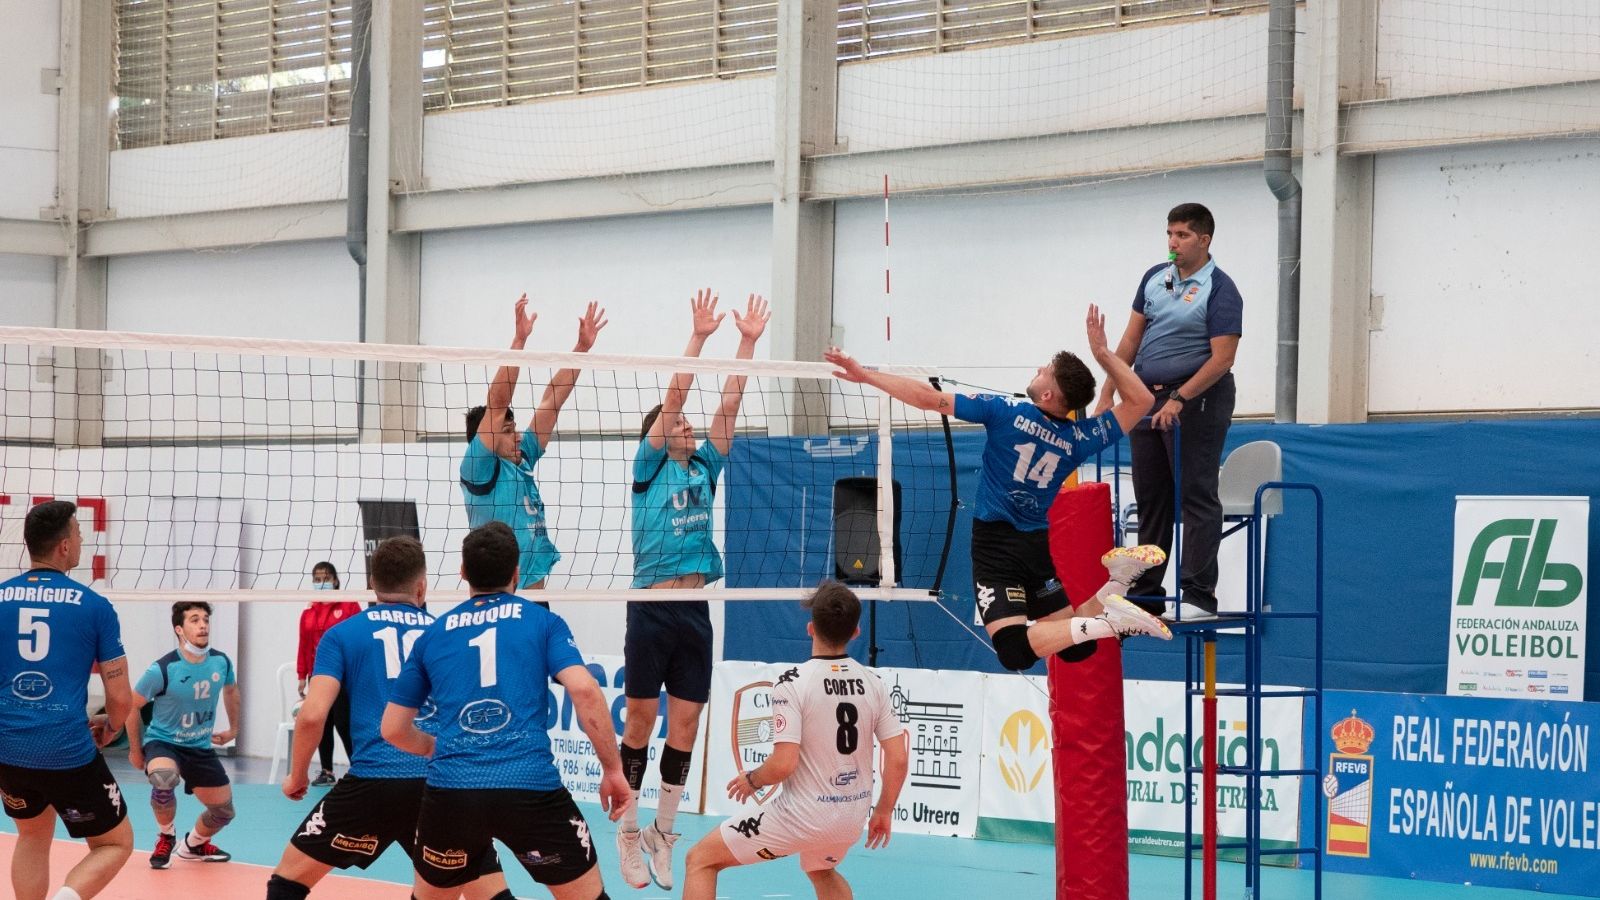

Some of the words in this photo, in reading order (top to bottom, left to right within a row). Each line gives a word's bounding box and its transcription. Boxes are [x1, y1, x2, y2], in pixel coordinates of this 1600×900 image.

[1013, 442, 1061, 489] 14
[446, 603, 523, 631] BRUQUE
[1456, 617, 1520, 630] FEDERACIÓN
[1522, 619, 1579, 631] ANDALUZA
[18, 607, 51, 662] 5
[1456, 633, 1579, 659] VOLEIBOL
[468, 626, 497, 688] 1
[193, 680, 211, 700] 12
[823, 678, 866, 696] CORTS
[836, 701, 858, 755] 8
[1392, 715, 1445, 764] REAL
[1452, 711, 1589, 773] FEDERACIÓN
[563, 758, 579, 775] 986
[1335, 761, 1368, 774] RFEVB
[912, 802, 960, 826] Utrera
[1389, 780, 1498, 842] ESPAÑOLA
[1504, 796, 1533, 844] DE
[1470, 852, 1558, 875] www.rfevb.com
